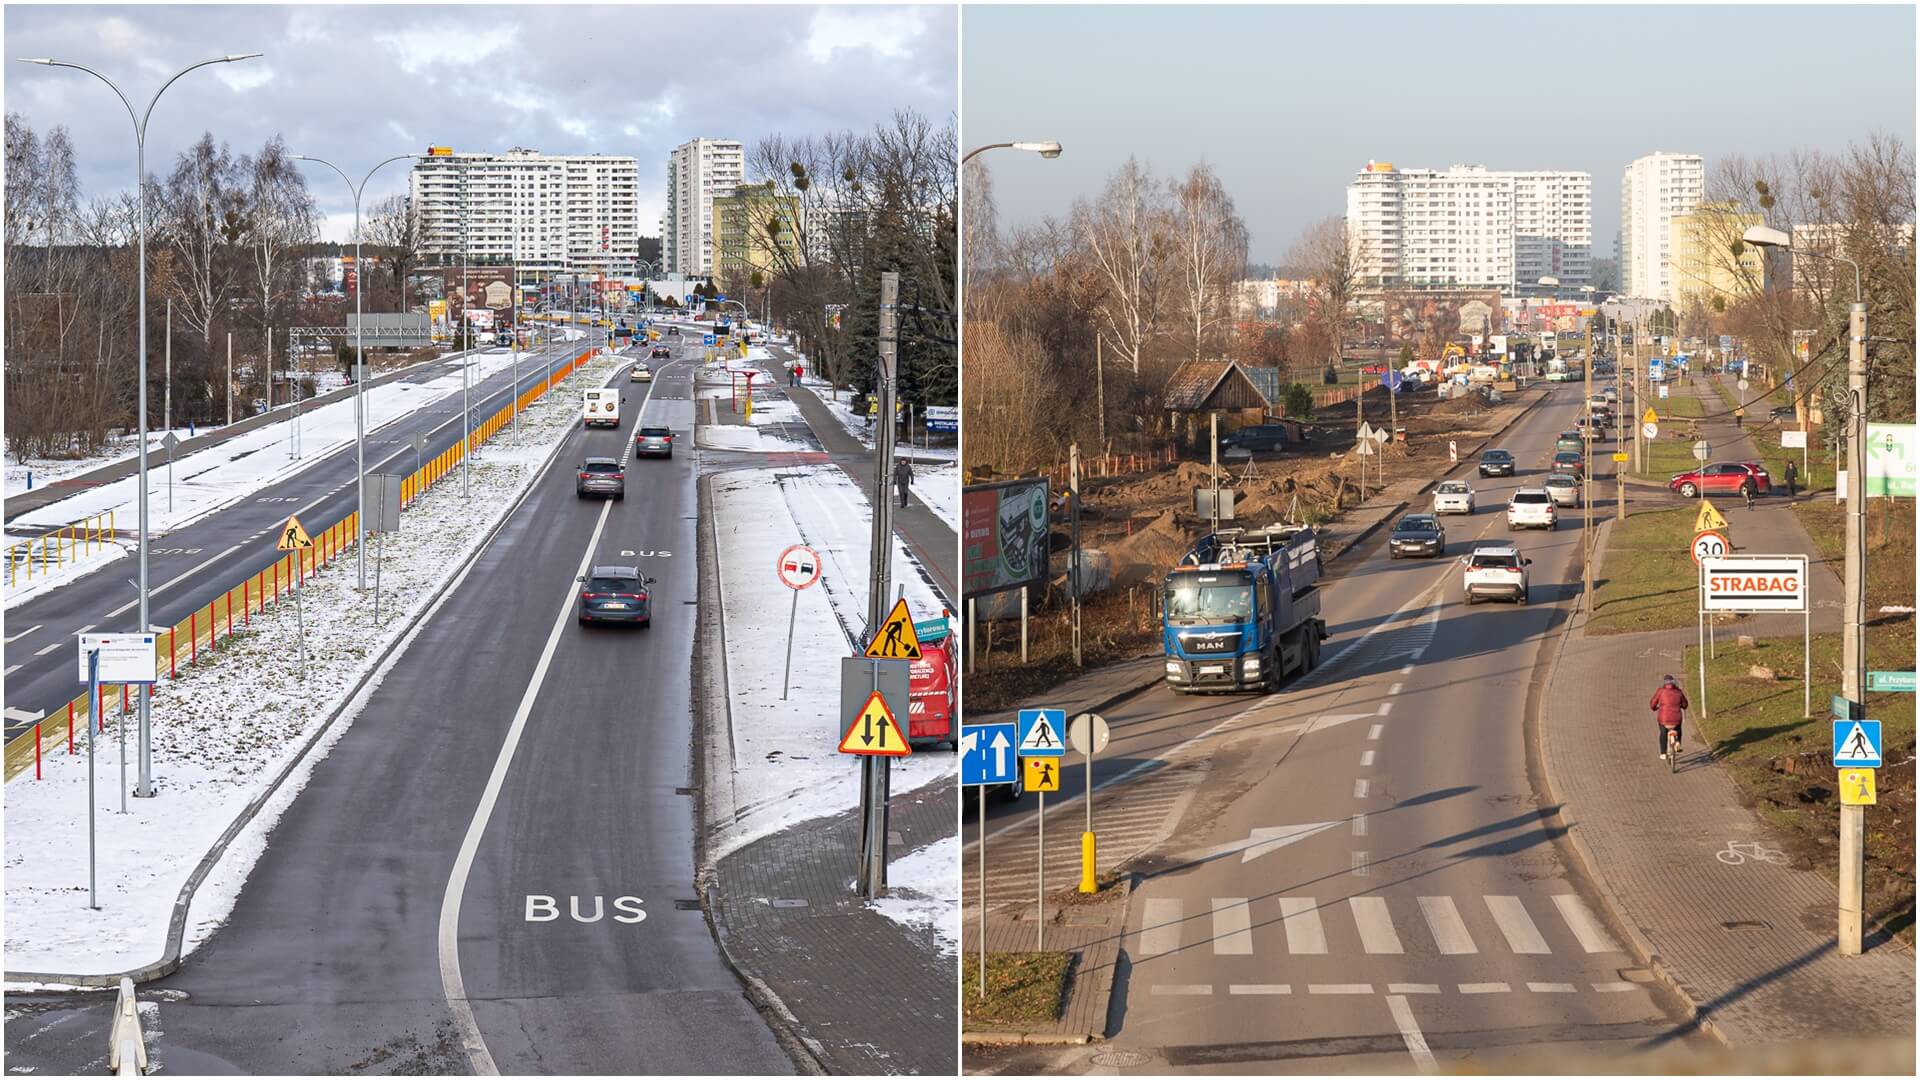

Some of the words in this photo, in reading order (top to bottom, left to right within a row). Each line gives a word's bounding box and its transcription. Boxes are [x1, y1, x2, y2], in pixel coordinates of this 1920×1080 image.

[1698, 541, 1723, 559] 30
[1710, 577, 1798, 592] STRABAG
[1196, 641, 1224, 650] MAN
[524, 894, 648, 924] BUS
